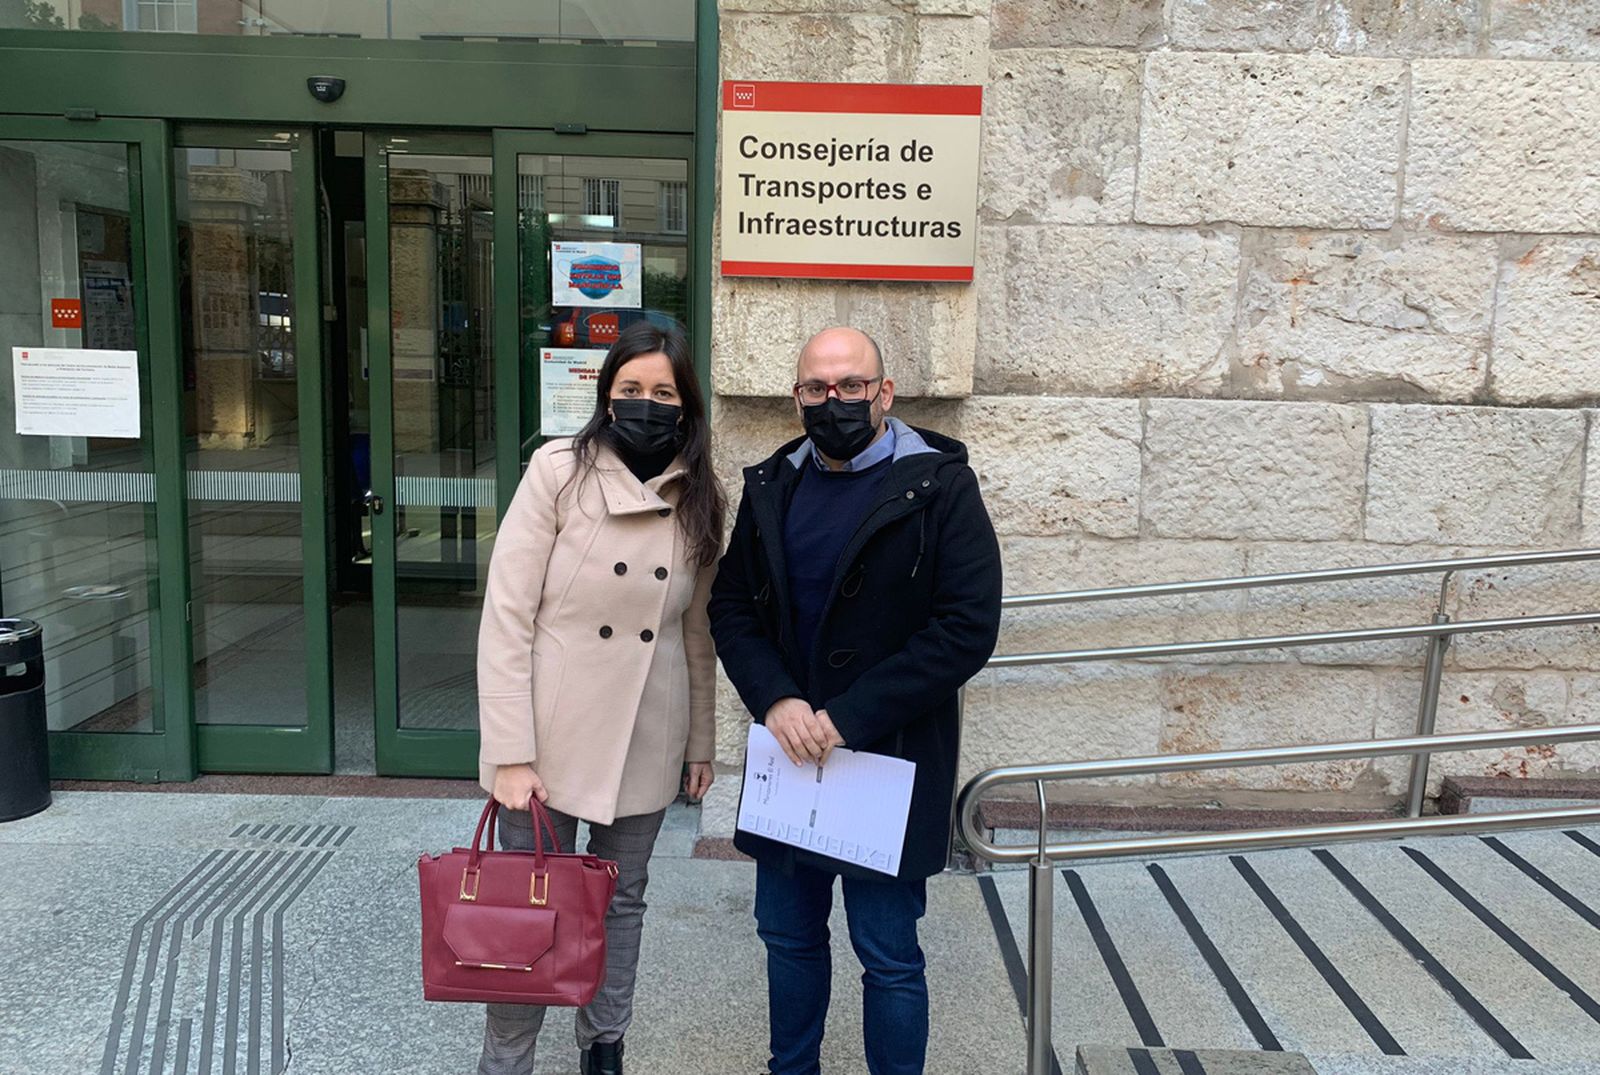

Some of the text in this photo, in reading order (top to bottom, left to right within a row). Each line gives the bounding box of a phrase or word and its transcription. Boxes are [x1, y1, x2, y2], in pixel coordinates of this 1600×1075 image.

[739, 135, 934, 167] Consejería de
[738, 173, 932, 204] Transportes e
[738, 211, 961, 239] Infraestructuras
